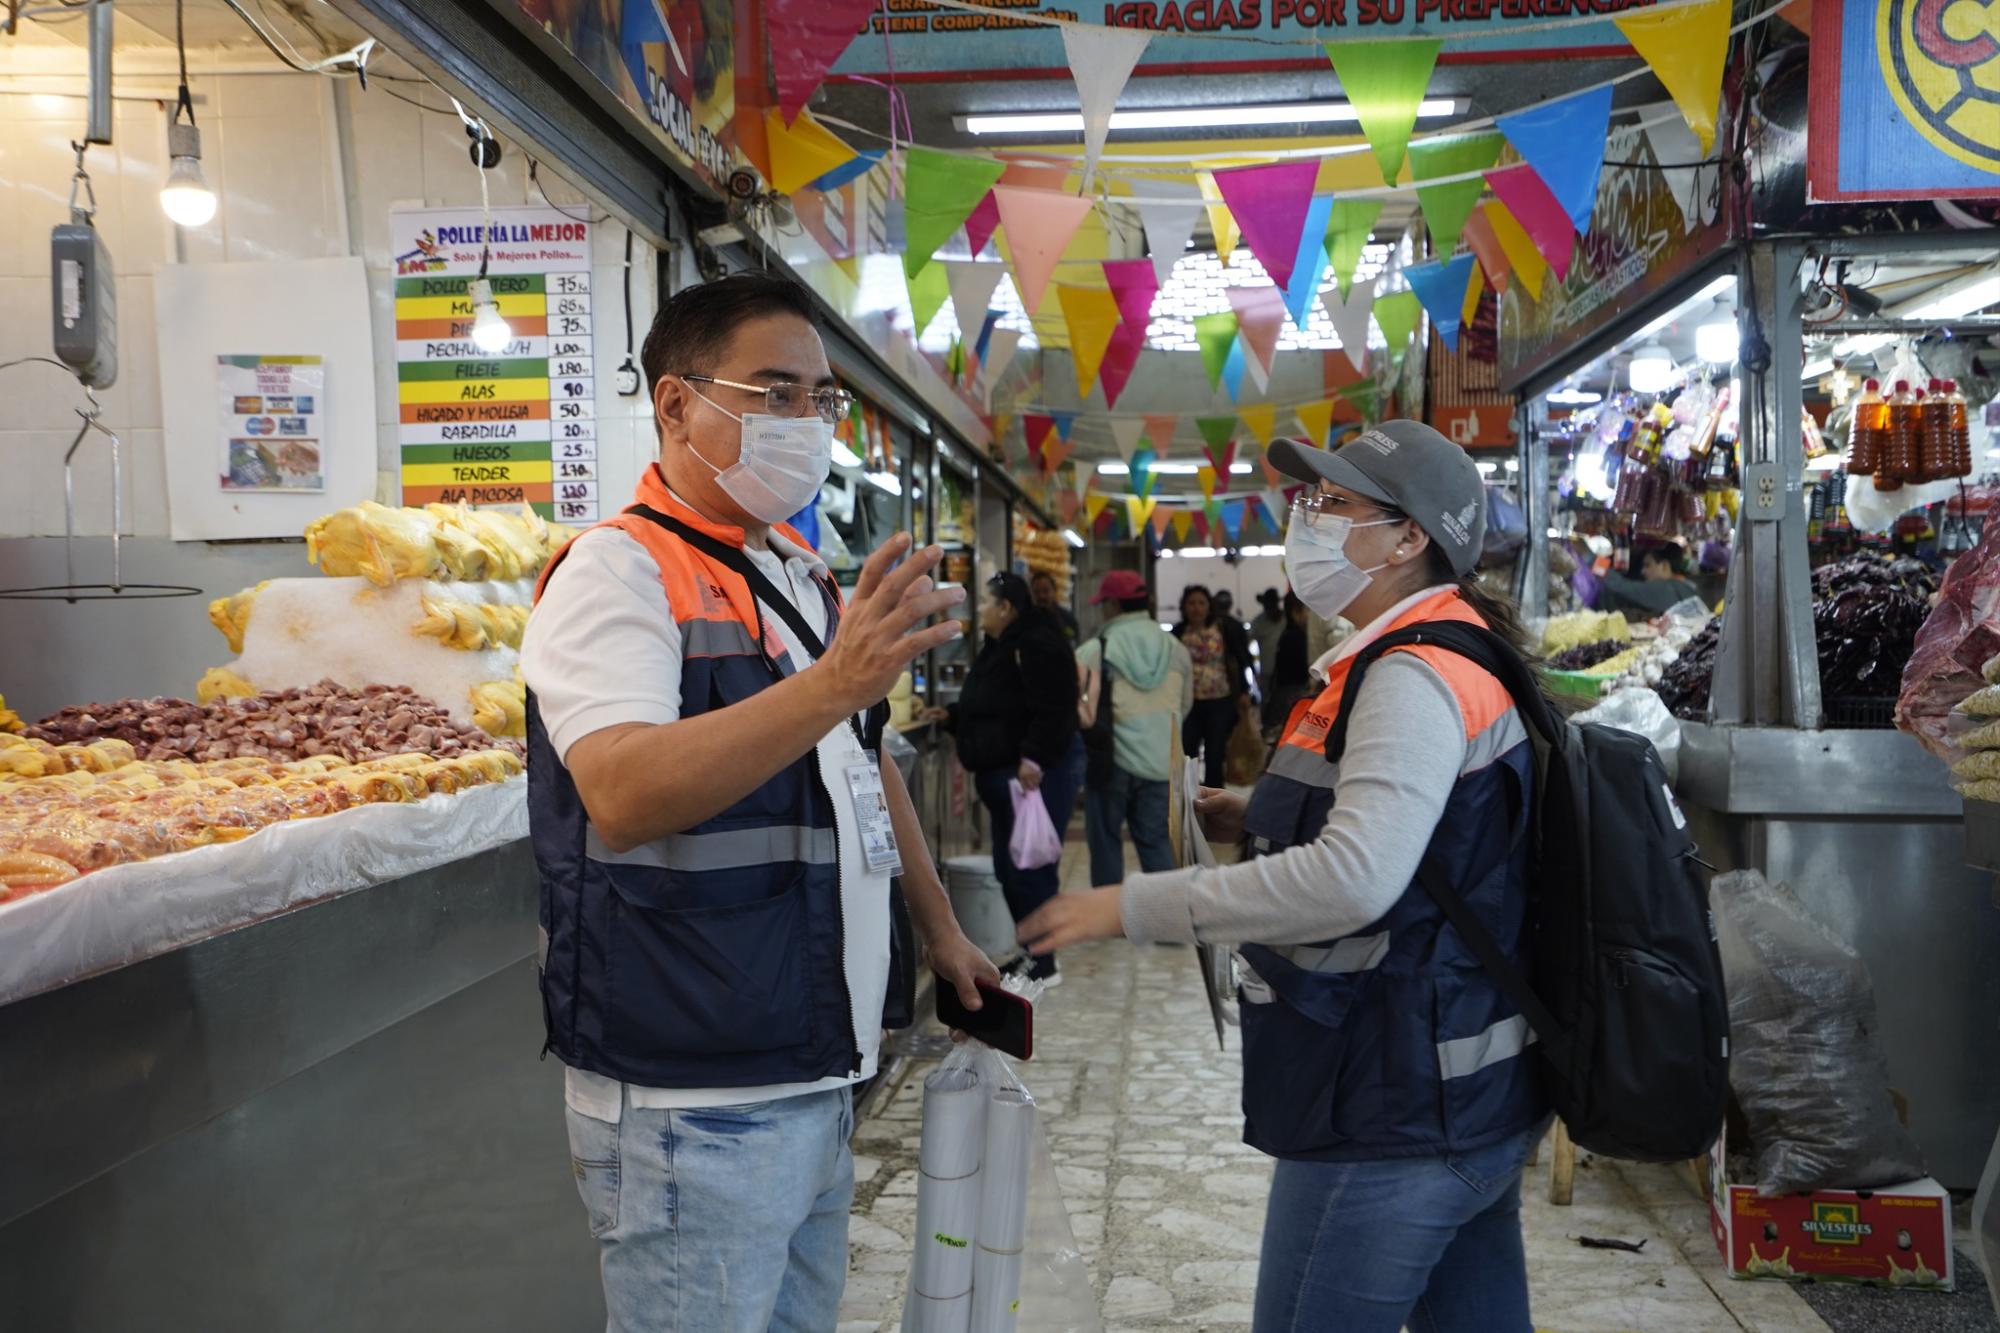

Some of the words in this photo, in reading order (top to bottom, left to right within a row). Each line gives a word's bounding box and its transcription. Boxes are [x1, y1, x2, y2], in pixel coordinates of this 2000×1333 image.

[1272, 0, 1347, 28] POR
[1358, 0, 1405, 25] SU
[648, 66, 697, 161] LOCAL
[512, 224, 529, 242] LA
[530, 223, 586, 242] MEJOR
[454, 252, 476, 262] Solo
[479, 251, 493, 261] ls
[497, 251, 537, 263] Mejores
[422, 280, 468, 296] POLLO
[557, 275, 577, 293] 75
[452, 301, 500, 315] MUO
[560, 317, 580, 336] 75
[455, 363, 501, 378] FILETE
[461, 385, 496, 399] ALAS
[563, 382, 584, 398] 90
[416, 407, 464, 422] HIGADO
[467, 406, 476, 421] Y
[478, 405, 529, 421] MOLLEJA
[560, 403, 580, 418] 50
[441, 424, 517, 440] RABADILLA
[563, 423, 581, 437] 20
[453, 445, 511, 461] HUESOS
[563, 443, 583, 457] 25
[453, 466, 510, 481] TENDER
[440, 488, 467, 503] ALA
[472, 488, 525, 502] PICOSA
[1801, 1221, 1873, 1236] SILVESTRES
